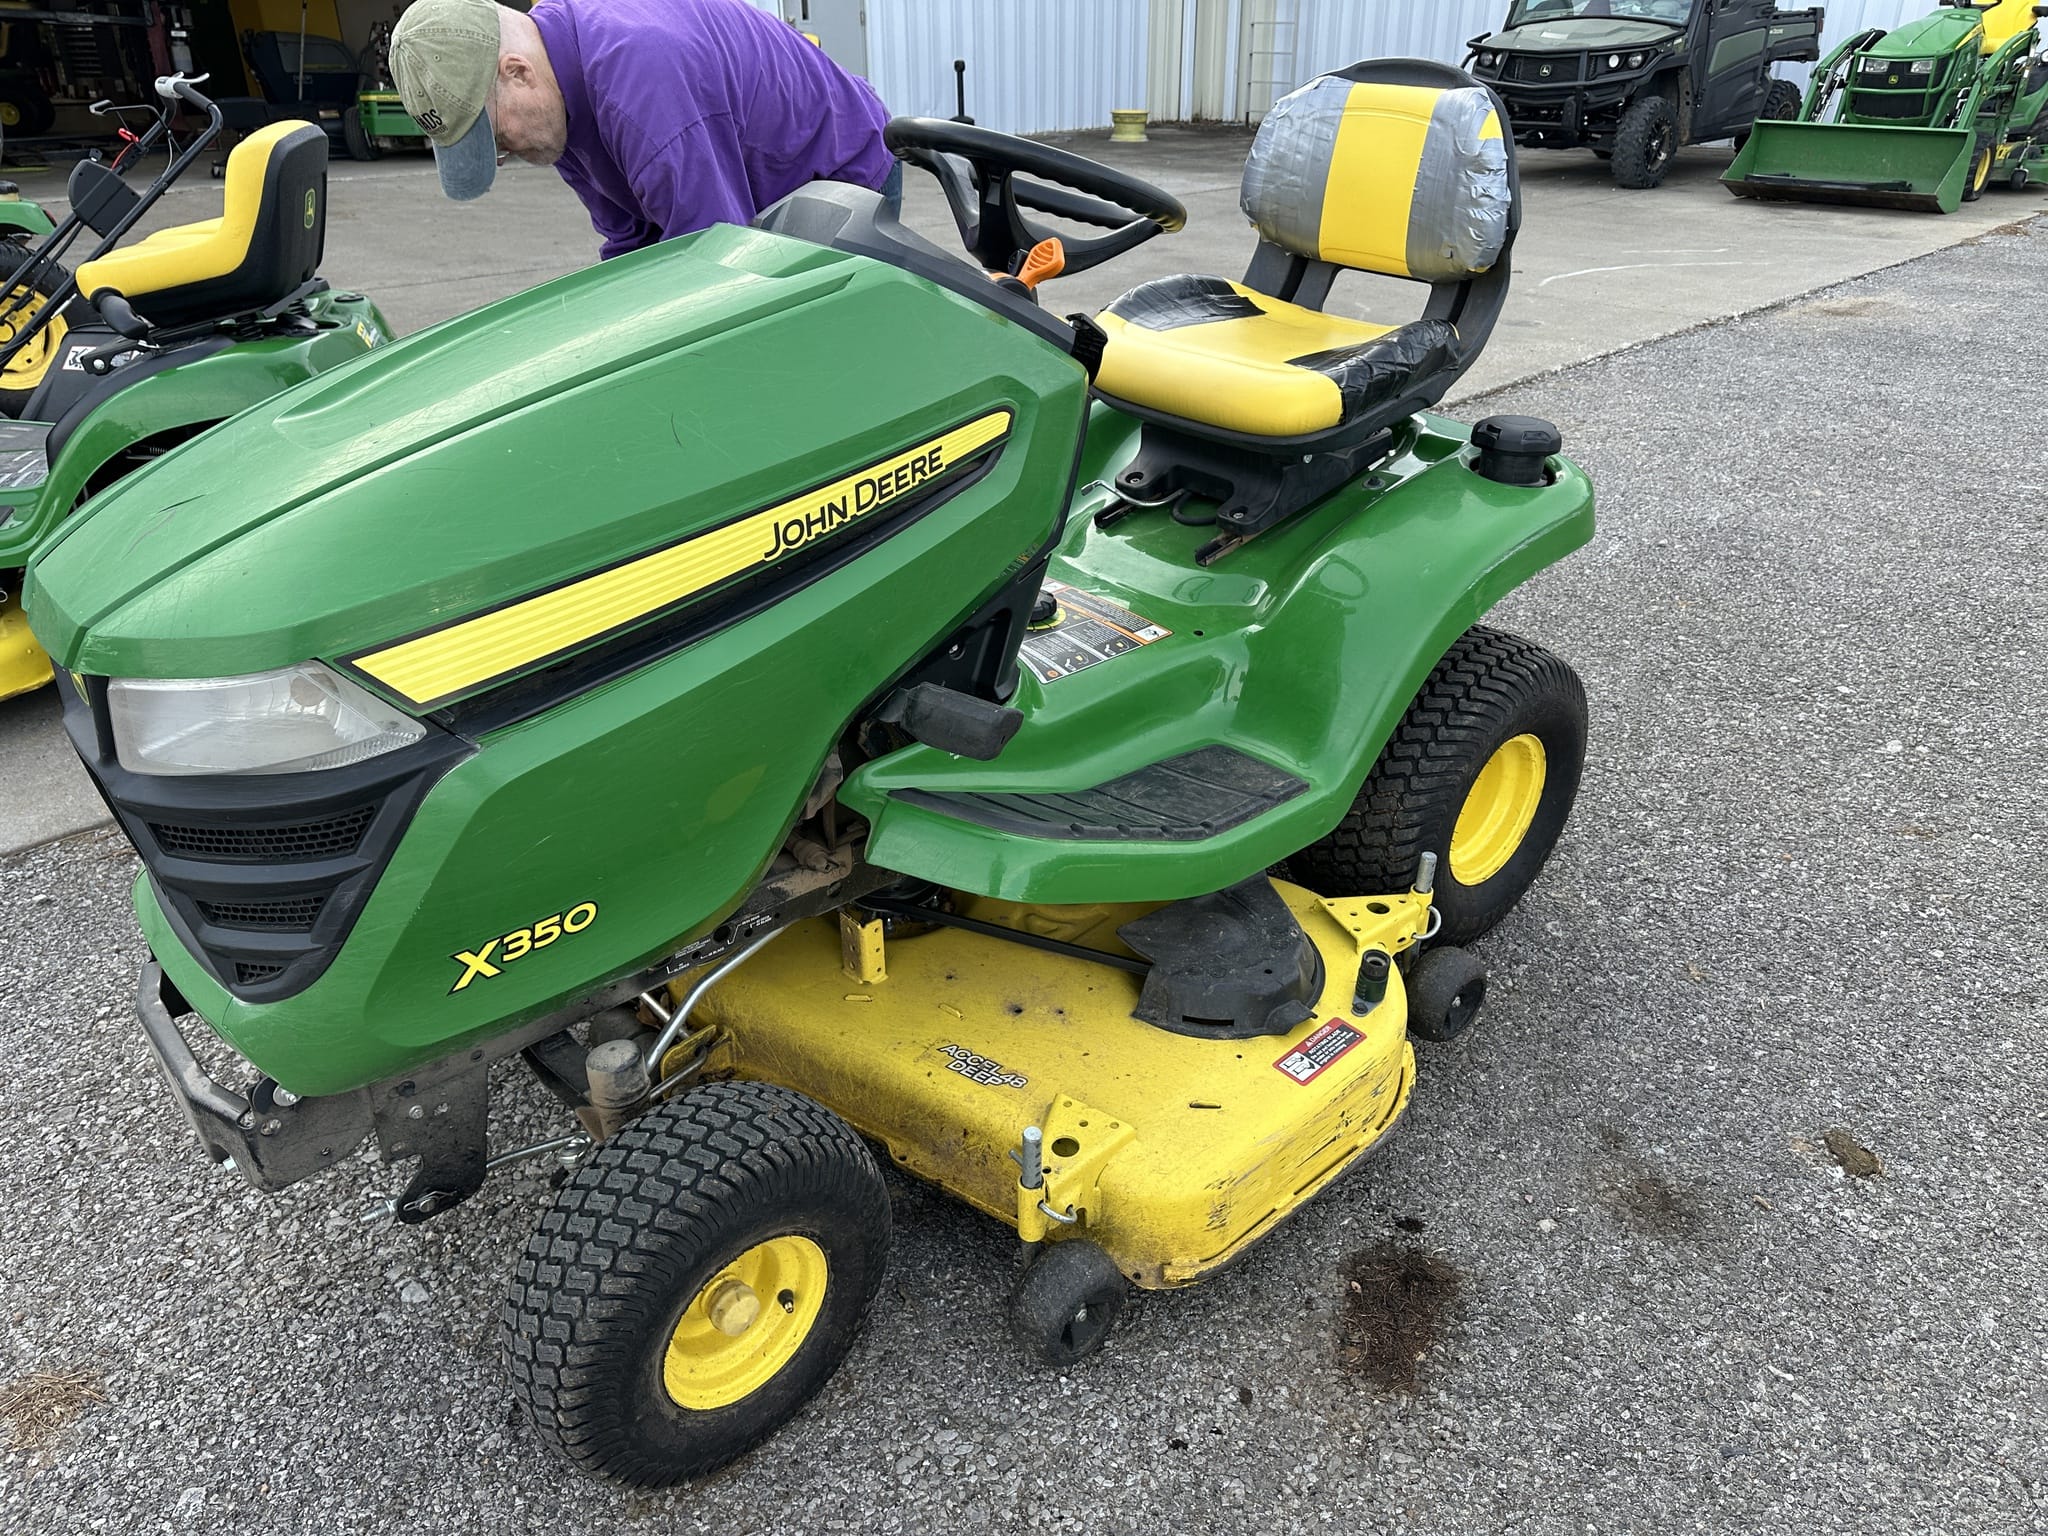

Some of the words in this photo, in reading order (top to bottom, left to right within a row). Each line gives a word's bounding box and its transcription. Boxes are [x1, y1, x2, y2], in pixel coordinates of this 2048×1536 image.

[764, 496, 847, 559] JOHN
[855, 446, 943, 512] DEERE
[447, 901, 598, 995] X350
[1309, 1025, 1332, 1042] DANGER
[945, 1059, 1004, 1085] DEEP
